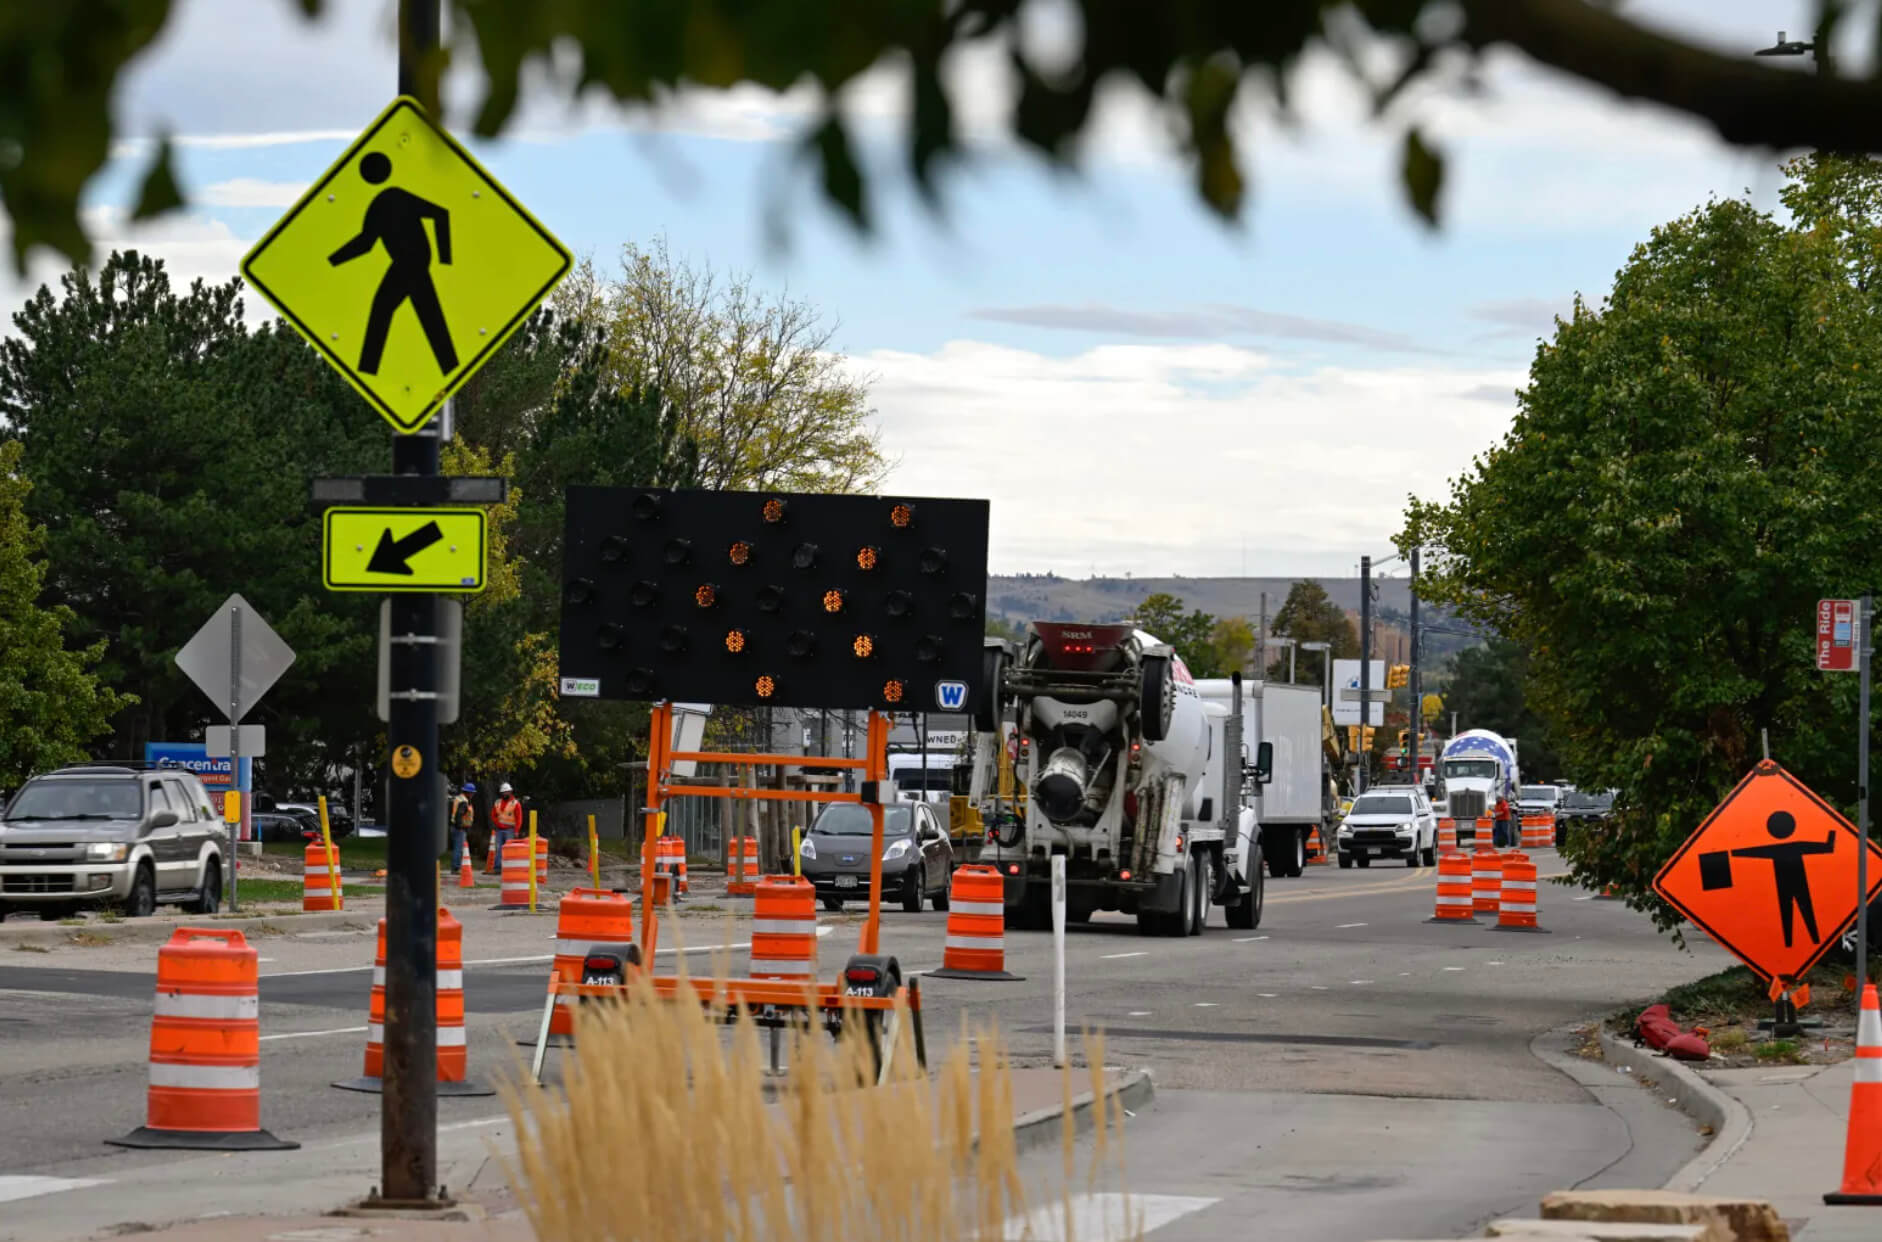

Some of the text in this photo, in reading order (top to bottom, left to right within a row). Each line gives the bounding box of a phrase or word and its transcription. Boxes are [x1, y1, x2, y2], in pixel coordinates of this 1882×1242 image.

[1819, 602, 1832, 665] The Ride
[941, 685, 964, 706] W
[1063, 710, 1088, 719] 14049
[927, 735, 957, 745] WNED
[586, 976, 616, 985] A-113
[846, 986, 874, 997] A-113
